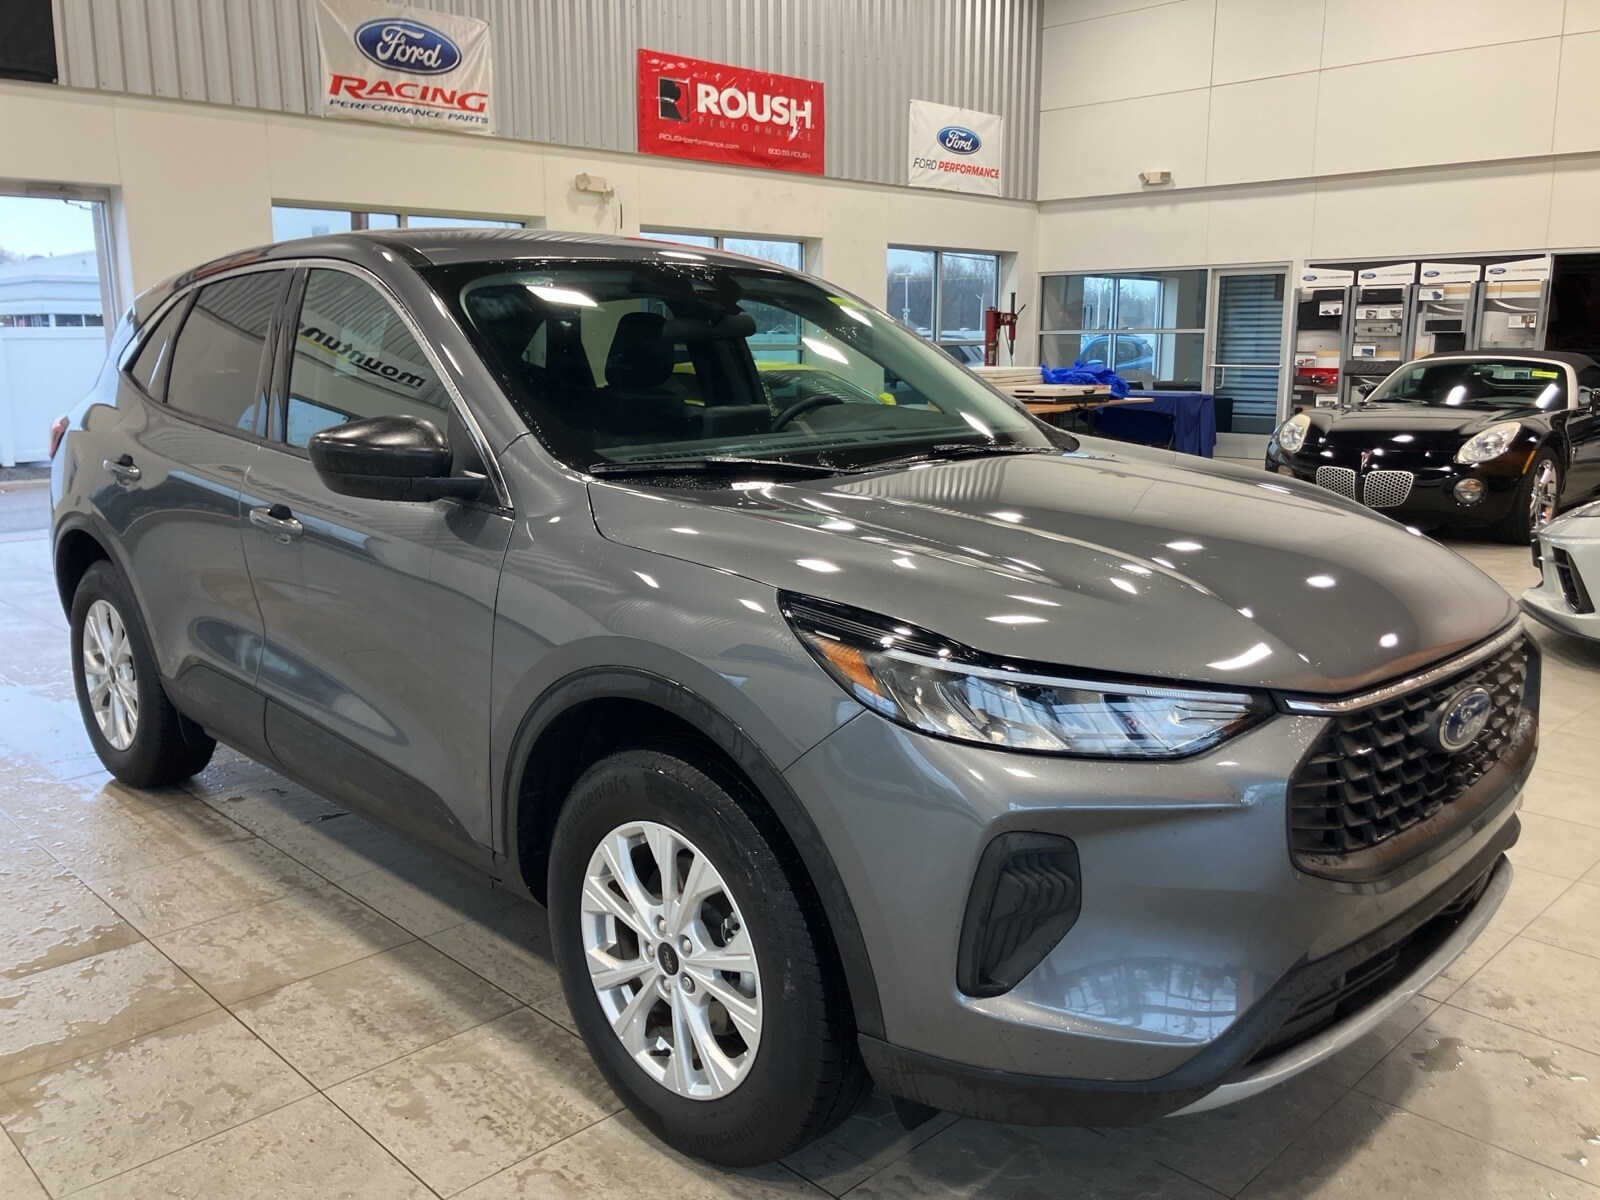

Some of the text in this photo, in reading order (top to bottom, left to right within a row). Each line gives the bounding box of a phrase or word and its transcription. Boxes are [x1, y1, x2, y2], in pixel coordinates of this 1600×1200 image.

[376, 25, 443, 68] Ford
[329, 74, 488, 113] RACING
[696, 83, 812, 129] ROUSH
[329, 99, 489, 124] PERFORMANCE PARTS
[945, 130, 973, 151] Ford
[912, 157, 1000, 179] FORD PERFORMANCE
